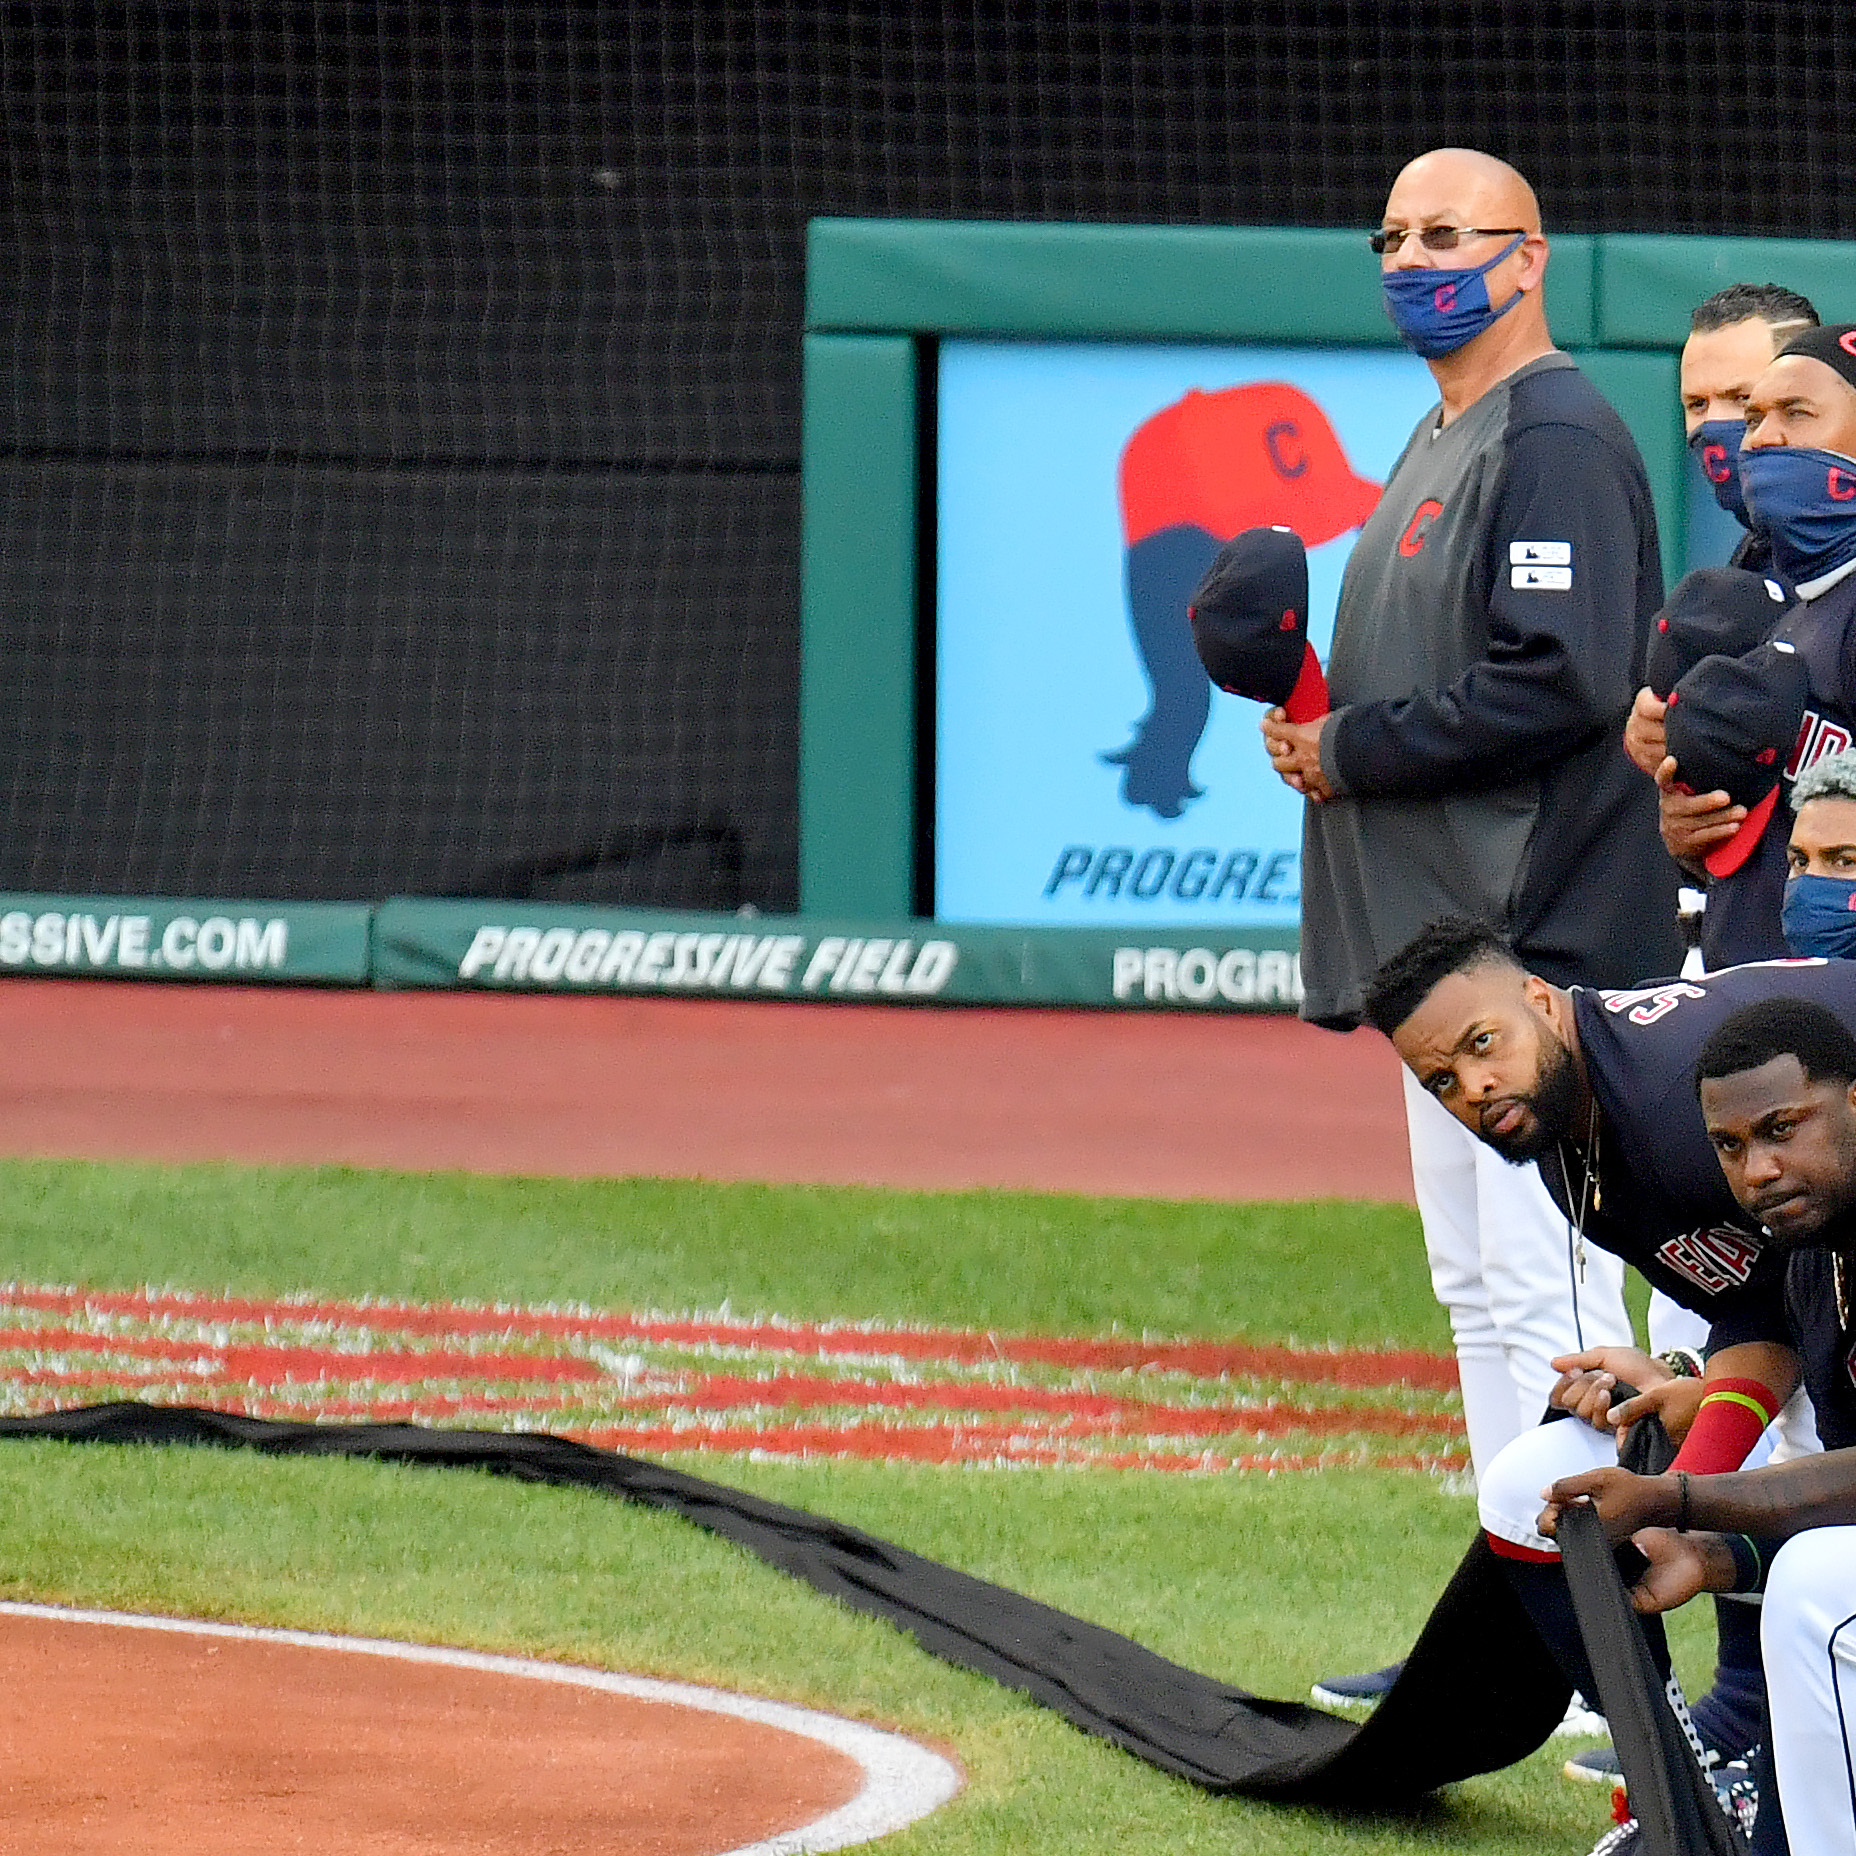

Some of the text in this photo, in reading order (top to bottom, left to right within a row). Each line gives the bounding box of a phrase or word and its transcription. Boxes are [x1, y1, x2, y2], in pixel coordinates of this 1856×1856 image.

[1434, 283, 1456, 313] C
[1266, 421, 1308, 478] C
[1703, 445, 1731, 483] C
[1399, 500, 1443, 556] C
[1041, 845, 1300, 903] PROGRE
[457, 925, 959, 996] PROGRESSIVE FIELD
